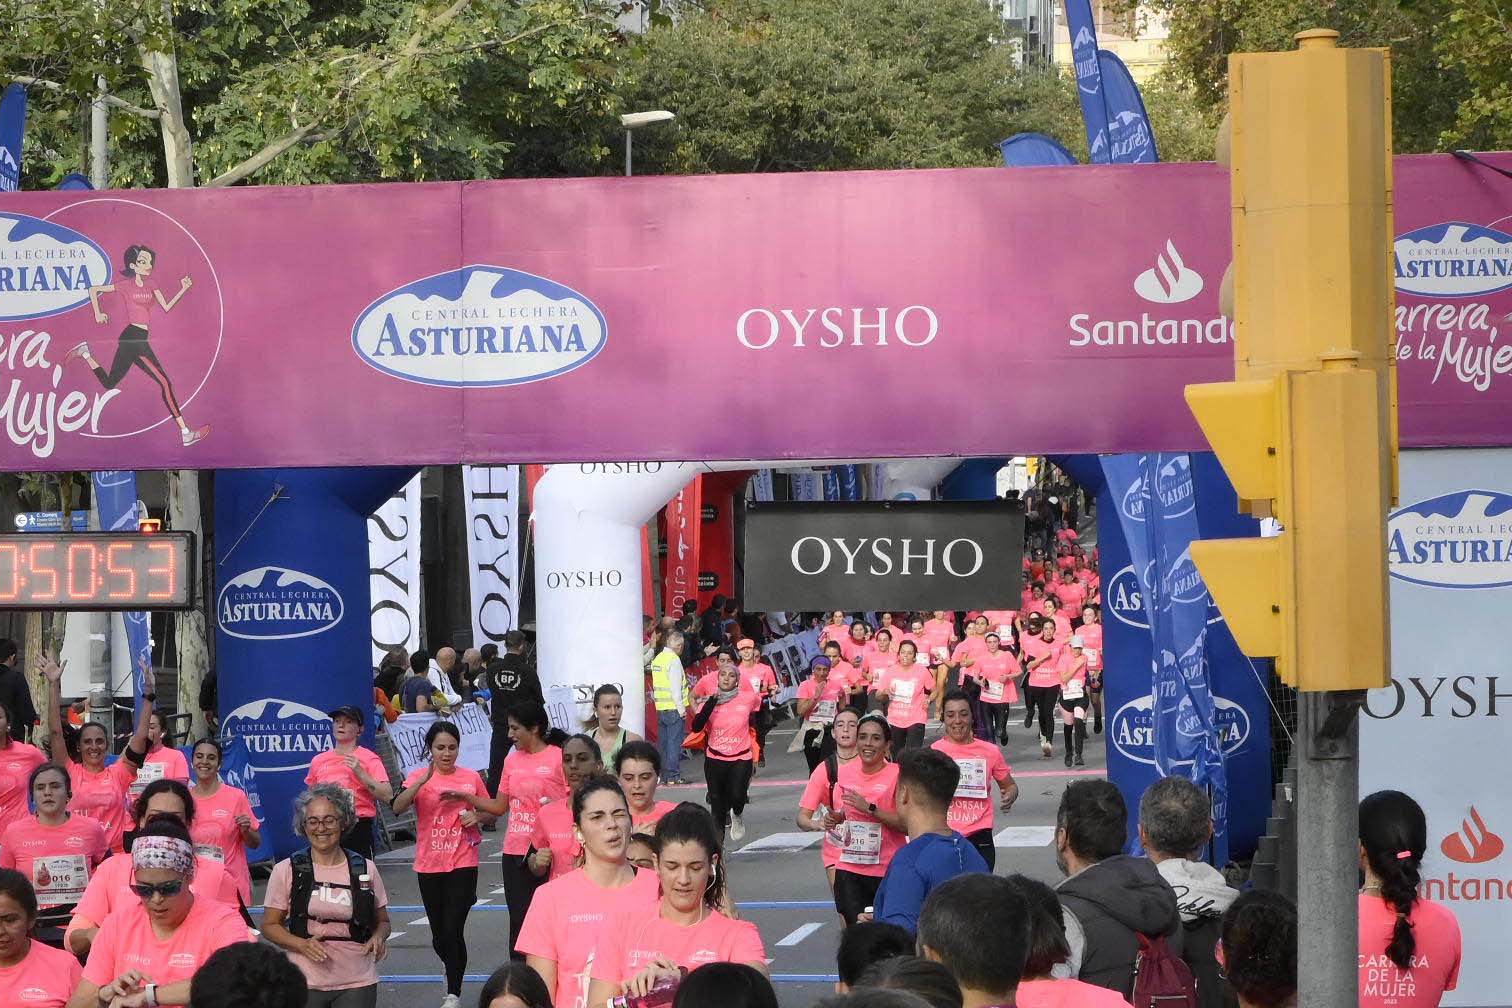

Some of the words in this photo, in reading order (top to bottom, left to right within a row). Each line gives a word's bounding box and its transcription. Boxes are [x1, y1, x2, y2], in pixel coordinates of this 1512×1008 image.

[14, 248, 87, 261] LECHERA
[411, 308, 490, 321] CENTRAL
[498, 306, 579, 319] LECHERA
[372, 311, 588, 358] ASTURIANA
[736, 304, 939, 350] OYSHO
[1417, 333, 1437, 360] la
[1415, 524, 1482, 536] CENTRAL
[790, 536, 985, 578] OYSHO
[546, 568, 622, 589] OYSHO
[234, 592, 278, 601] CENTRAL
[281, 591, 330, 600] LECHERA
[222, 595, 335, 624] ASTURIANA
[501, 674, 515, 684] BP
[51, 873, 71, 883] 016
[312, 887, 351, 906] ILA
[1368, 969, 1388, 982] DE
[1396, 969, 1414, 982] LA
[1363, 983, 1416, 997] MUJER
